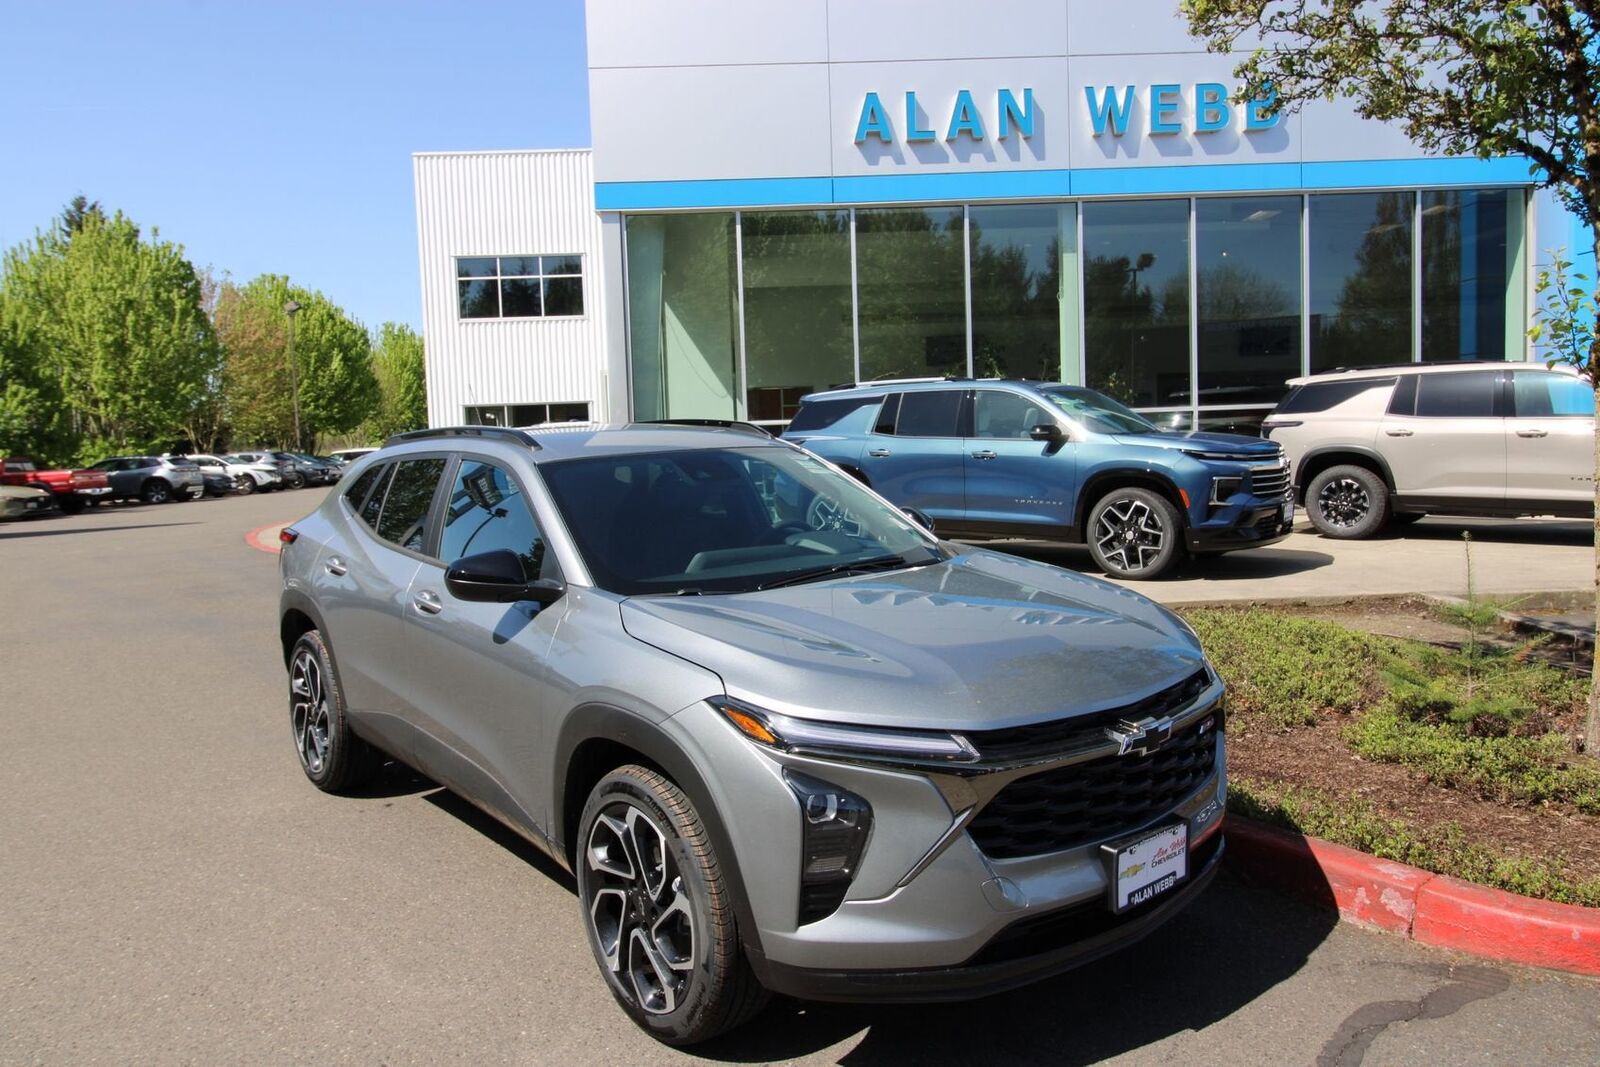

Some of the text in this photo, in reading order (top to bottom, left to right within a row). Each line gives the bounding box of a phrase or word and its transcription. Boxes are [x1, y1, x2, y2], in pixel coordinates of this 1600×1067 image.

[854, 83, 1281, 144] ALAN WEBB
[1151, 847, 1185, 868] CHEVROLET
[1133, 875, 1174, 905] ALAN WEBB
